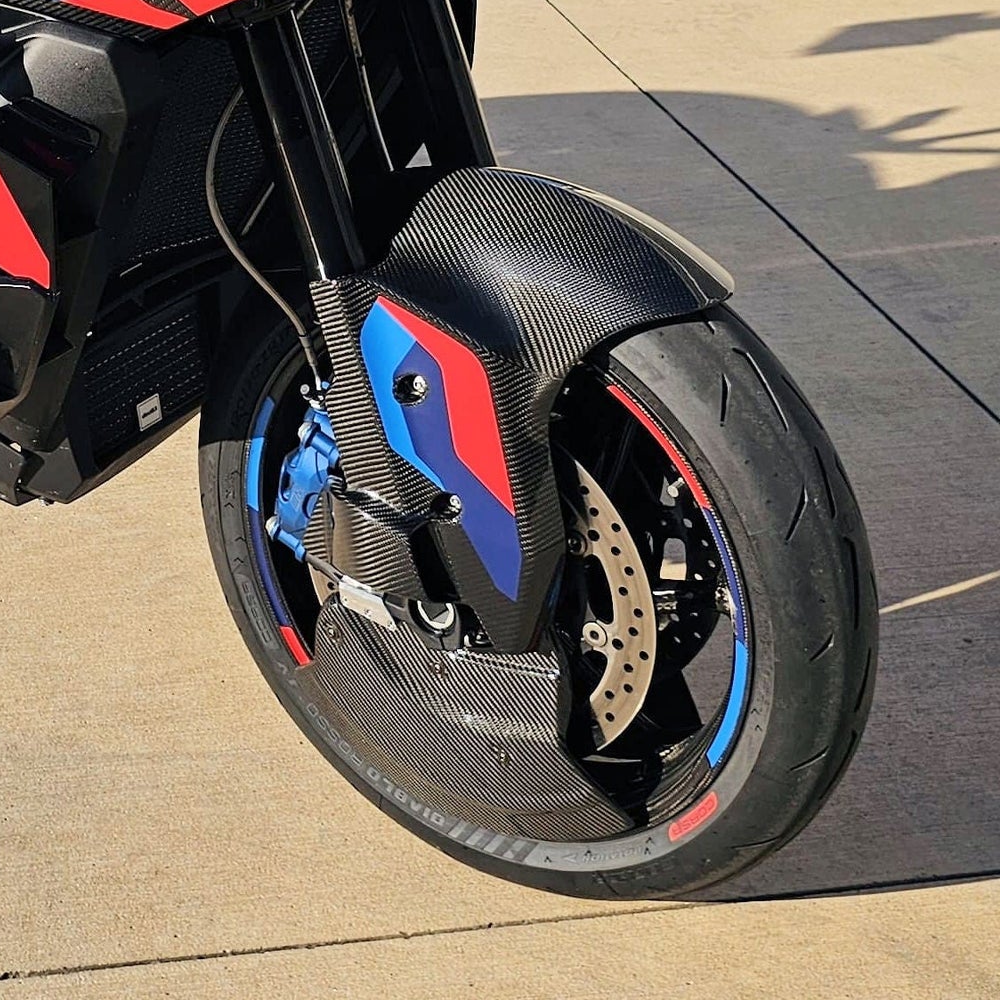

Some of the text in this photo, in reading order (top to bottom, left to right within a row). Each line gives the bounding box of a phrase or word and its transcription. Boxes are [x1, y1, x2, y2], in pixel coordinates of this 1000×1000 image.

[305, 701, 364, 768] ROSSO
[365, 766, 446, 827] DIABLO
[670, 793, 716, 839] CORSA
